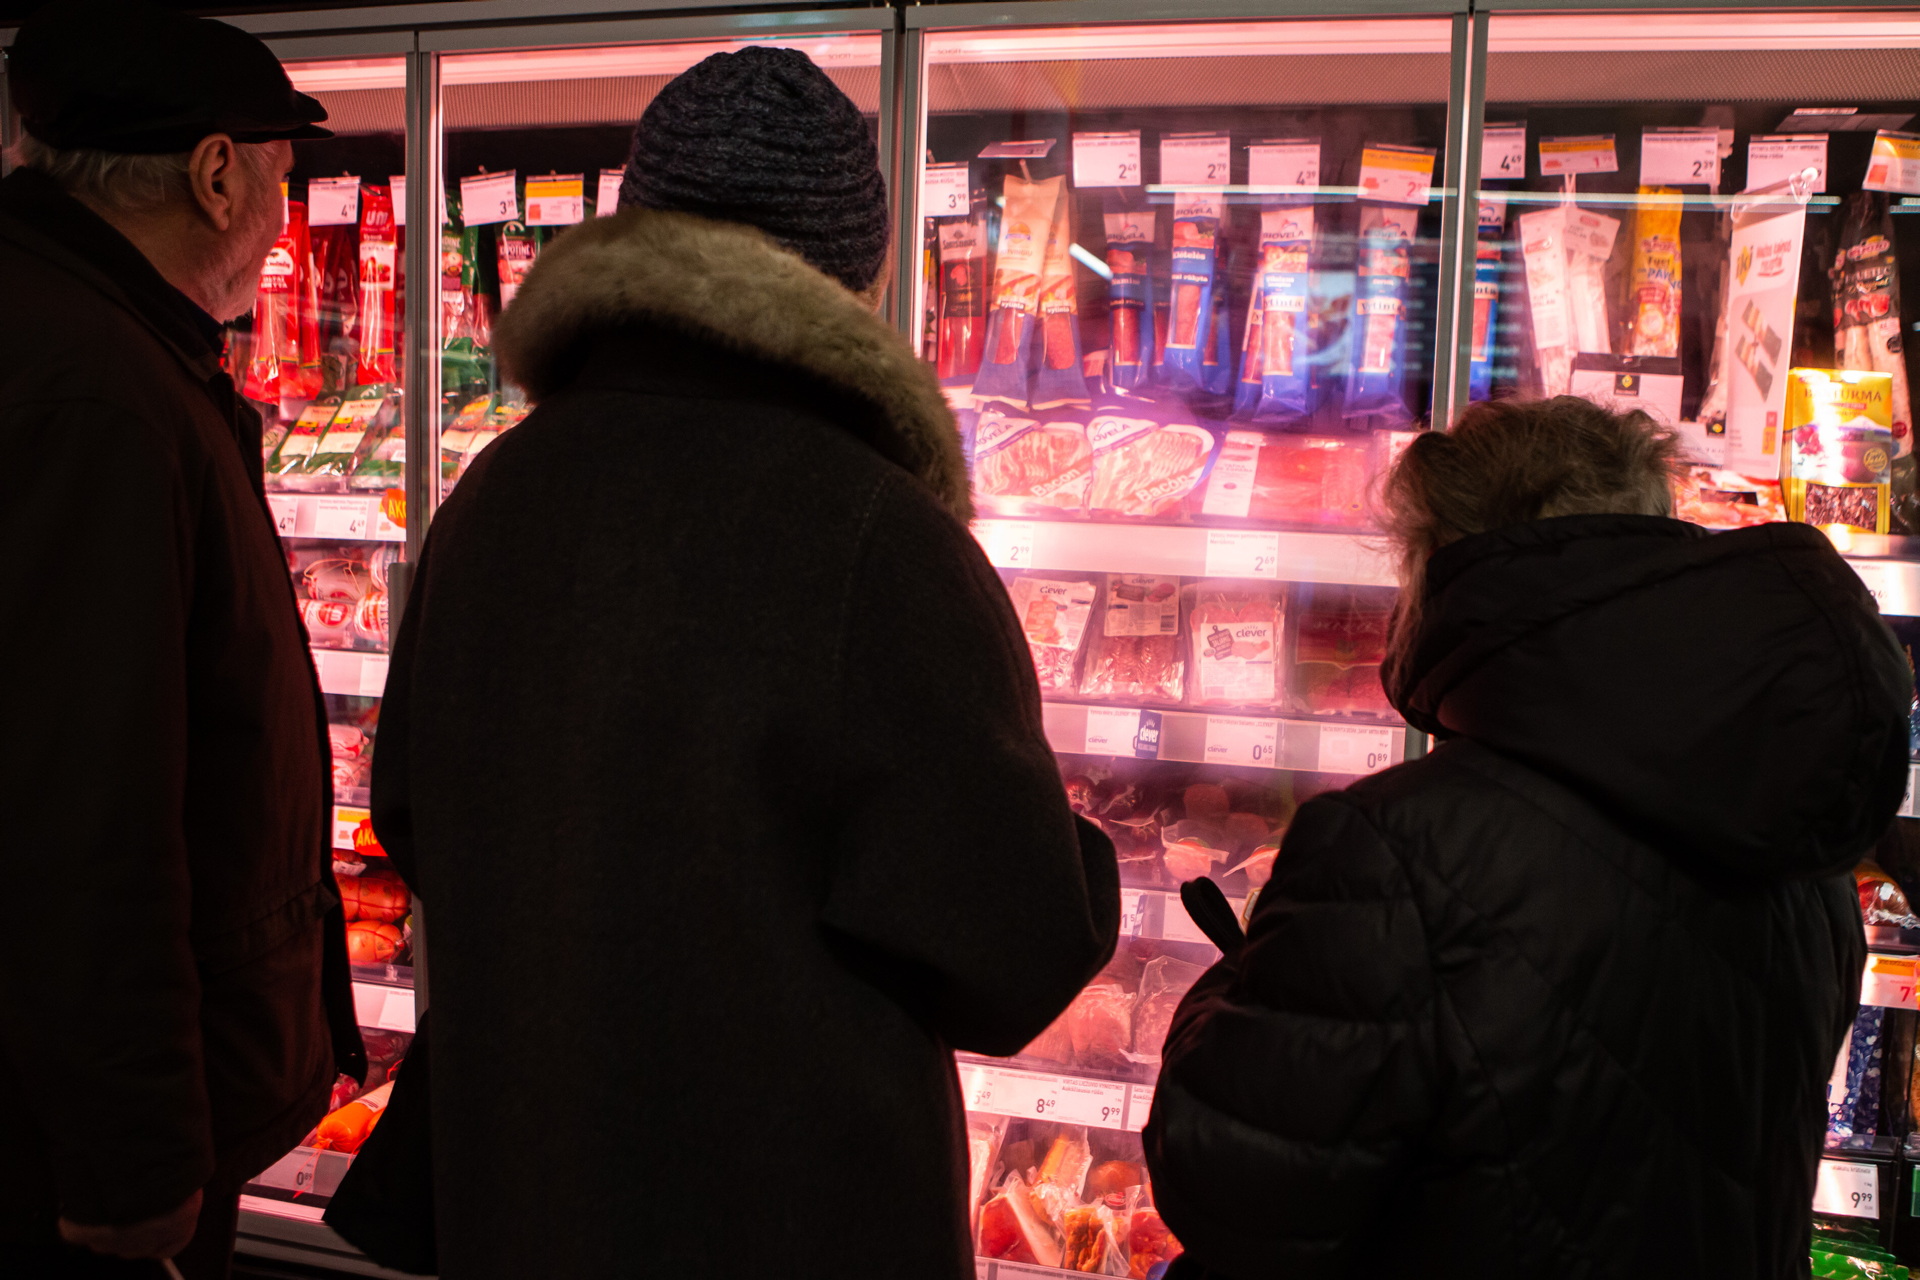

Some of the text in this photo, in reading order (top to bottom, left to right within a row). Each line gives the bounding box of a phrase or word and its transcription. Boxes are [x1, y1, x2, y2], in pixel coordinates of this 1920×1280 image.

[1030, 469, 1081, 497] Bacon
[1135, 474, 1188, 502] Bacon
[1254, 556, 1275, 572] 269
[1236, 629, 1267, 638] clever
[1252, 744, 1274, 761] 065
[1367, 752, 1388, 769] 089
[1036, 1098, 1056, 1113] 849
[1101, 1106, 1121, 1121] 999
[1850, 1191, 1873, 1209] 999
